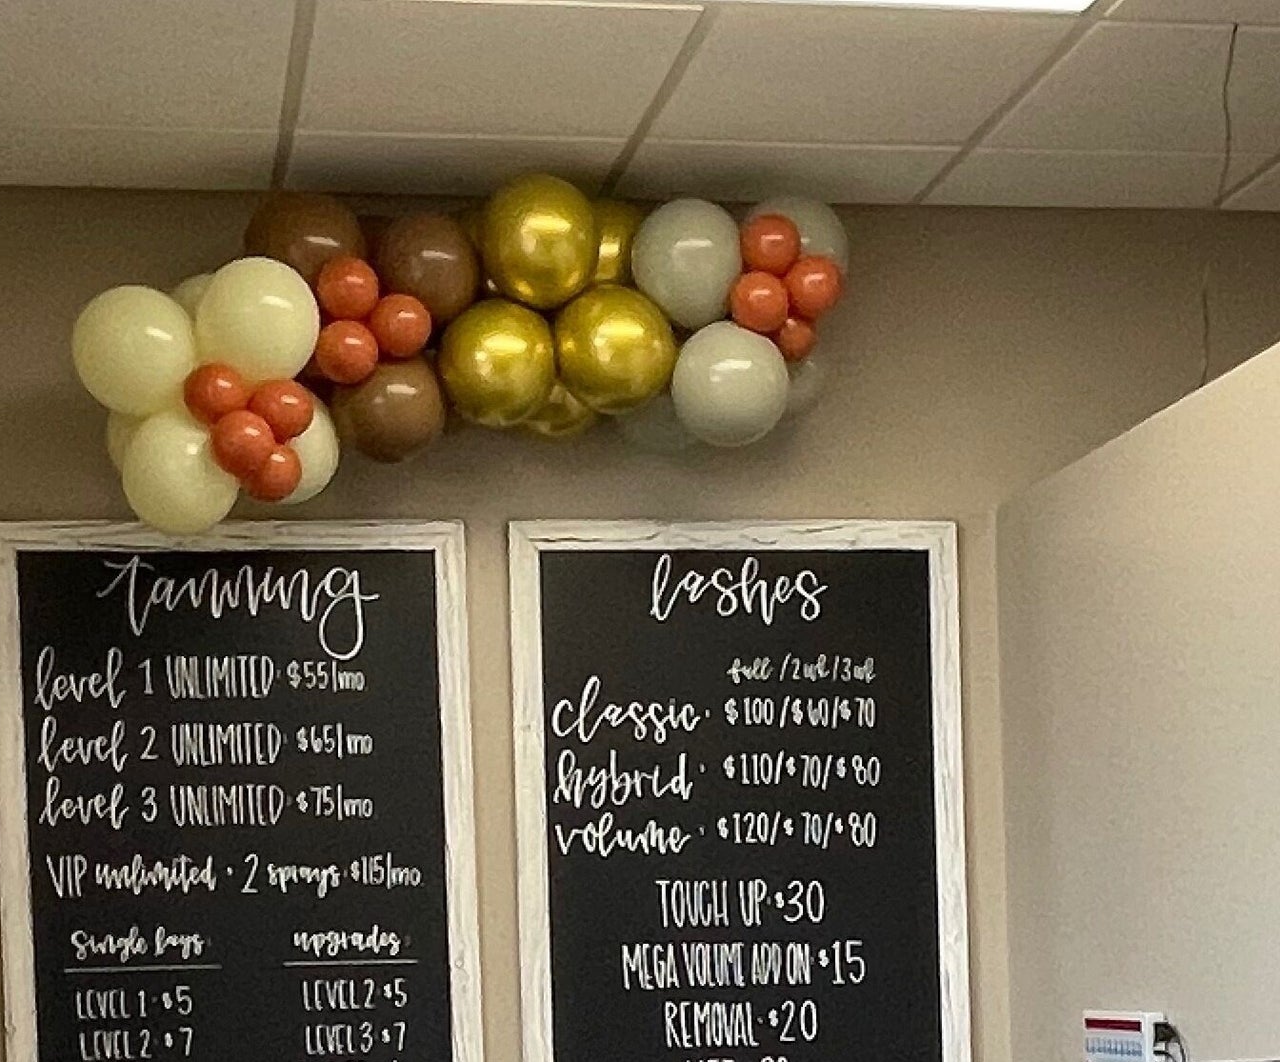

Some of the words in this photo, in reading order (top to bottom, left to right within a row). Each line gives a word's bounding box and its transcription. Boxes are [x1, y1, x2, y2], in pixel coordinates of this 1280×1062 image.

[96, 554, 380, 660] tanning
[649, 553, 829, 626] lashes
[34, 646, 126, 711] level
[138, 658, 154, 695] 1
[165, 655, 274, 699] UNLIMITED
[286, 659, 366, 693] $55/mo
[551, 675, 701, 745] classic
[37, 715, 129, 773] level
[140, 725, 159, 760] 2
[170, 722, 282, 767] UNLIMITED
[296, 722, 373, 760] $65/mo
[38, 775, 130, 830] level
[141, 787, 158, 823] 3
[169, 783, 284, 827] UNLIMITED
[295, 783, 373, 821] $75/mo
[552, 749, 694, 810] hybrid
[554, 811, 692, 858] volume
[46, 854, 88, 898] VIP
[95, 853, 217, 896] unlimited
[240, 853, 259, 894] 2
[266, 863, 341, 899] sprays
[655, 879, 730, 928] TOUCH
[738, 878, 768, 927] UP
[774, 880, 825, 924] $30
[293, 924, 402, 958] upgrades
[621, 943, 680, 991] MEGA
[680, 941, 746, 988] VOLUME
[751, 941, 783, 985] ADD
[785, 941, 812, 985] ON
[817, 939, 866, 985] $15
[76, 989, 130, 1019] LEVEL
[137, 990, 147, 1017] 1
[162, 985, 193, 1015] $5
[303, 979, 360, 1011] LEVEL
[363, 977, 375, 1009] 2
[383, 977, 408, 1008] $5
[79, 1030, 132, 1061] LEVEL
[139, 1029, 151, 1058] 2
[164, 1027, 193, 1056] $7
[305, 1023, 356, 1055] LEVEL
[358, 1021, 373, 1053] 3
[381, 1021, 406, 1052] $7
[664, 1000, 760, 1048] REMOVAL
[768, 999, 818, 1042] $20
